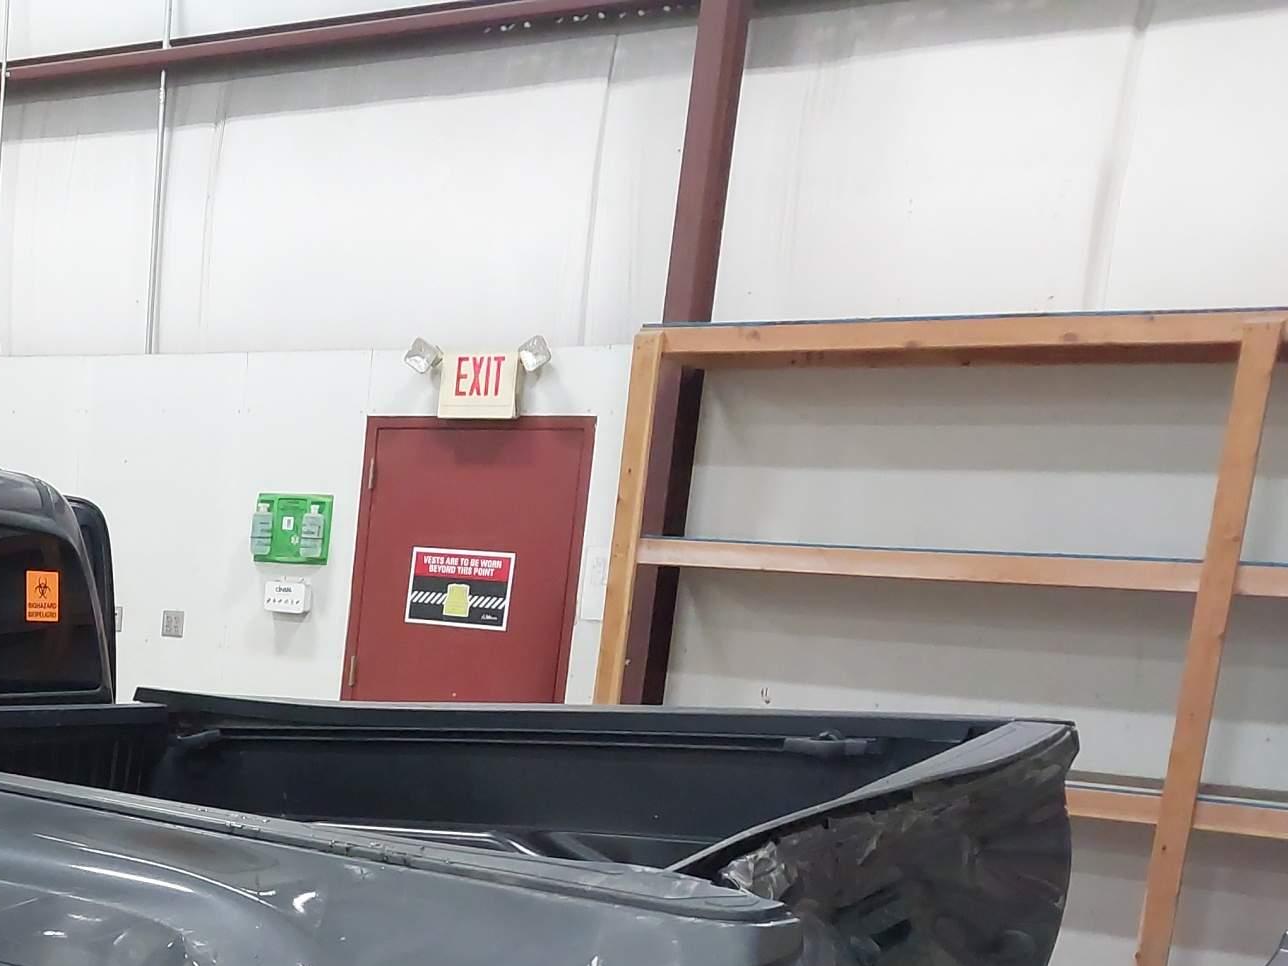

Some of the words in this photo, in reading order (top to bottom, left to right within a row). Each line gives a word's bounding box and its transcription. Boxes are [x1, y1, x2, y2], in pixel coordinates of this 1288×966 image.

[455, 356, 506, 397] EXIT
[423, 555, 445, 565] VESTS
[445, 557, 459, 567] ARE
[460, 557, 470, 567] TO
[470, 558, 480, 568] BE
[480, 559, 503, 569] WORN
[428, 564, 456, 574] BEYOND
[457, 565, 473, 576] THIS
[473, 567, 495, 577] POINT
[28, 602, 57, 610] BIOHAZARD
